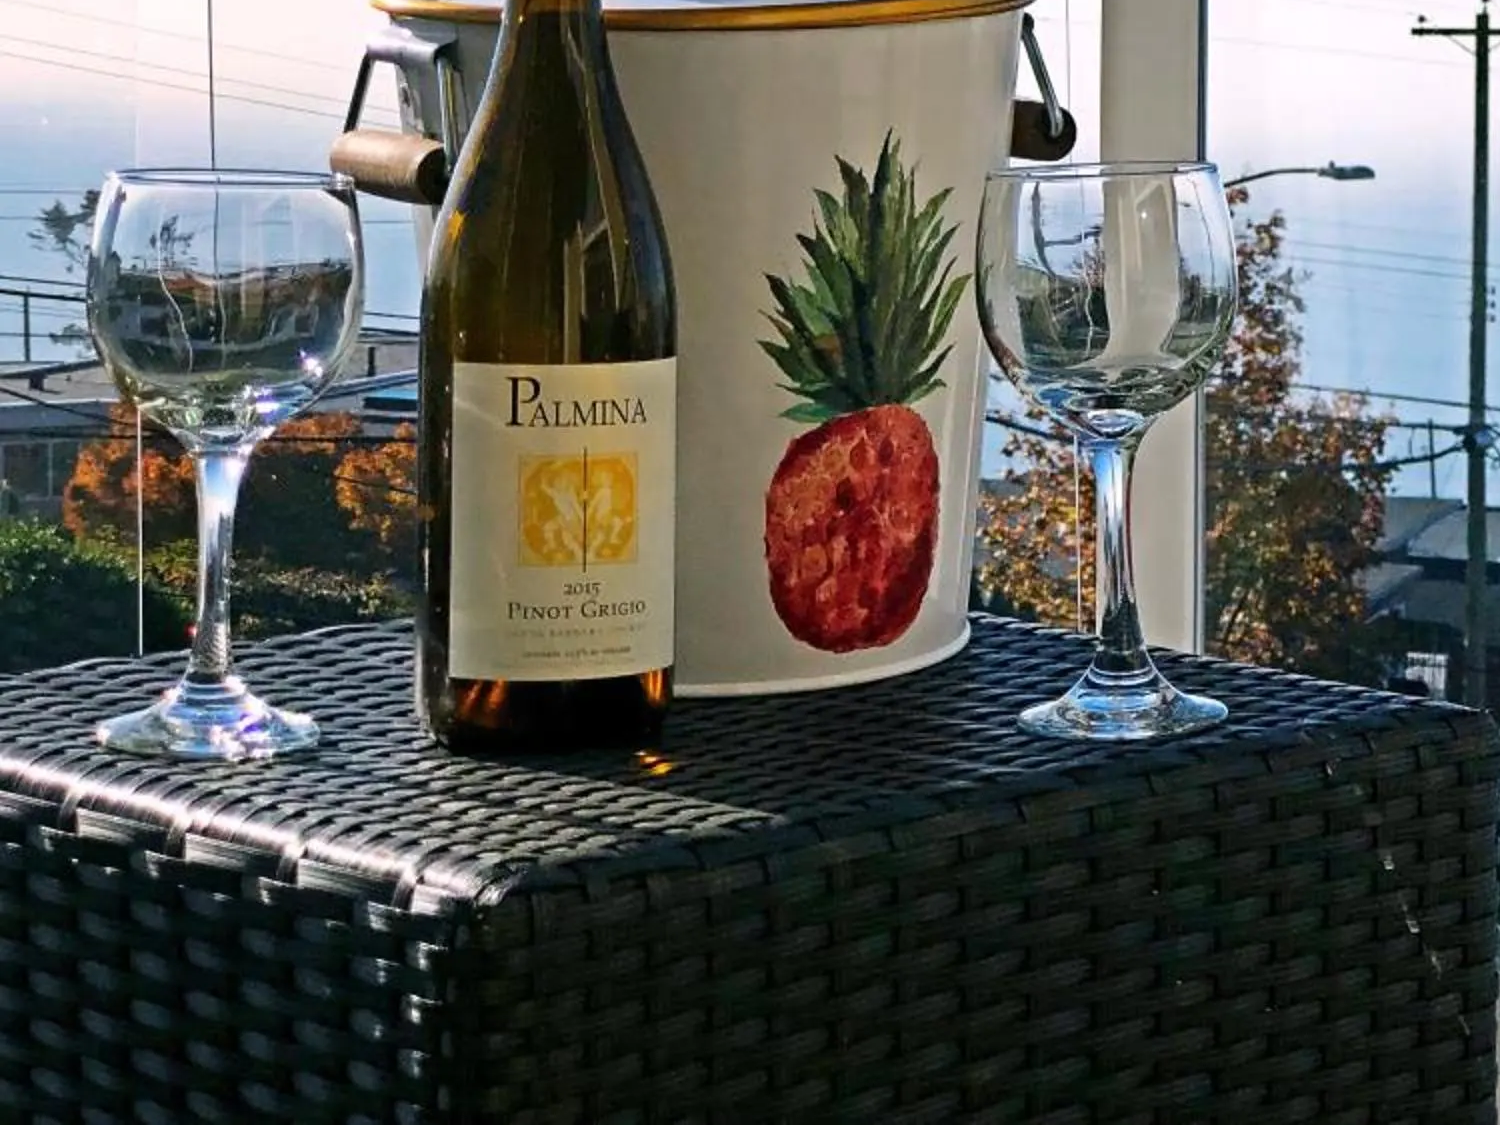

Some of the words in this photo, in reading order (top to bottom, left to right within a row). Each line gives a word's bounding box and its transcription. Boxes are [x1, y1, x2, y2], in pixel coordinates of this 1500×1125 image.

[505, 376, 648, 427] PALMINA
[563, 582, 601, 596] 2015
[508, 601, 573, 619] PINOT
[581, 600, 646, 618] GRIGIO
